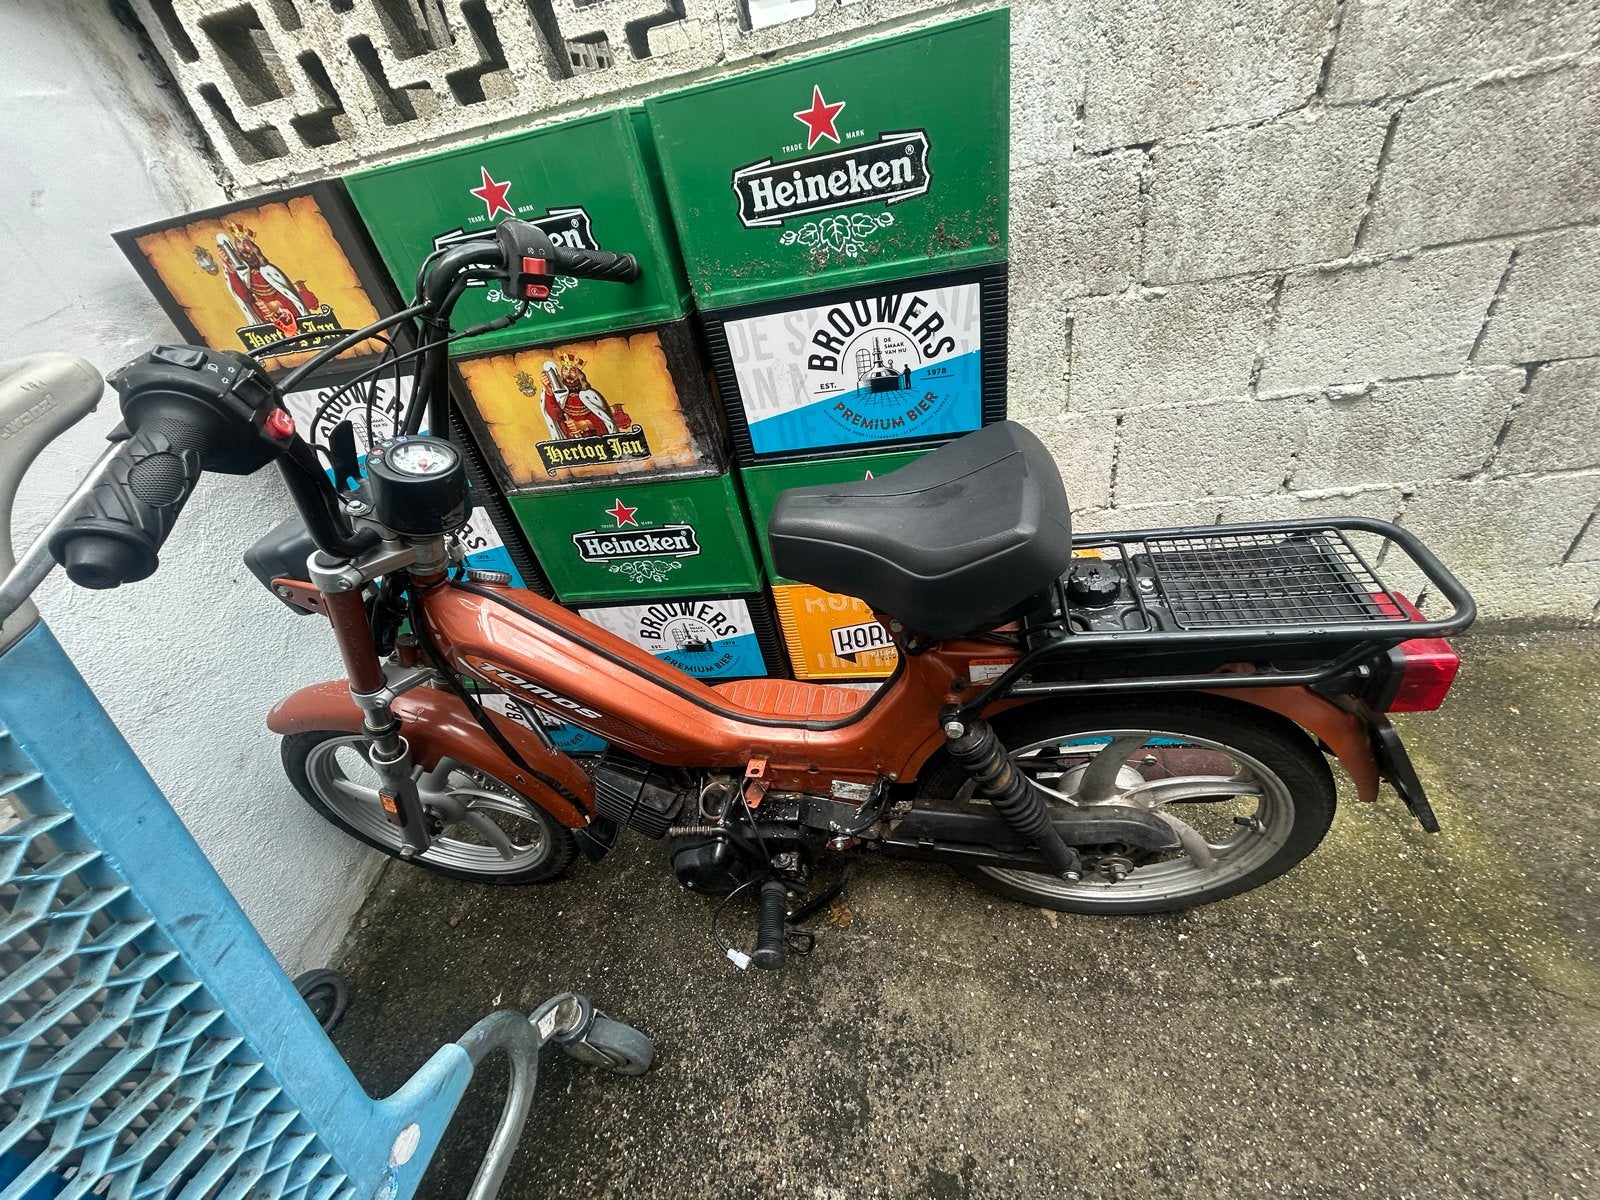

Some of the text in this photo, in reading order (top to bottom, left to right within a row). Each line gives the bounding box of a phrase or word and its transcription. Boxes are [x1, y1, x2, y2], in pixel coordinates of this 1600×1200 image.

[782, 129, 865, 153] TRADE MARK
[467, 204, 534, 223] TRADE MARK
[808, 294, 955, 372] BROUWERS
[819, 367, 947, 390] EST. 1978
[833, 401, 905, 430] PREMIUM
[906, 391, 938, 421] BIER
[543, 438, 644, 464] Hertog Jan
[583, 534, 691, 556] Heineken
[641, 602, 737, 640] BROUWERS
[663, 653, 734, 673] PREMIUM BIER
[479, 662, 603, 719] TOMOS
